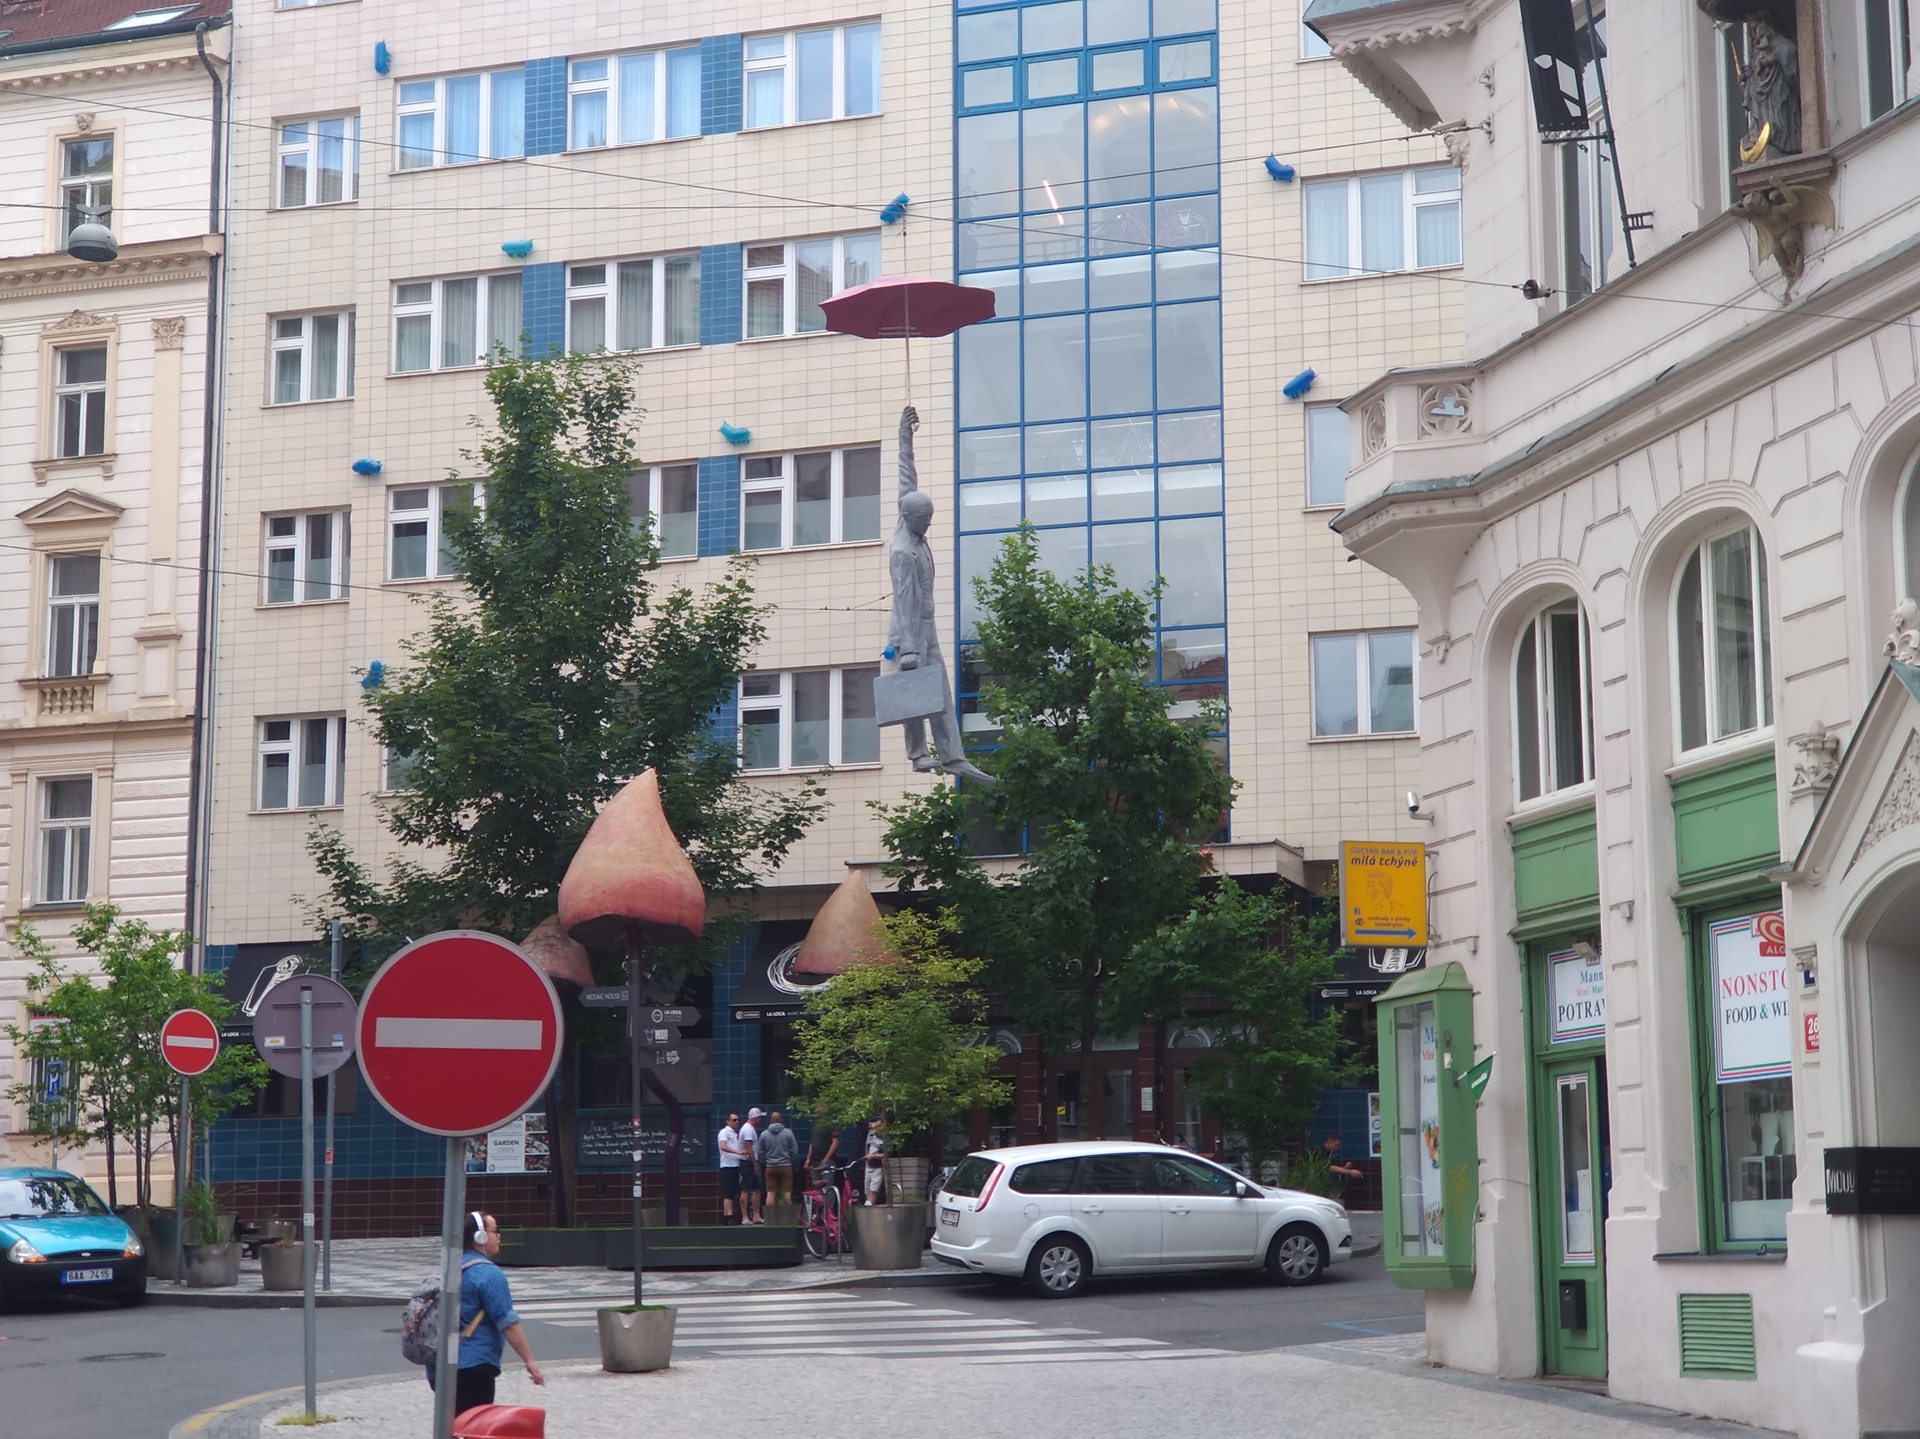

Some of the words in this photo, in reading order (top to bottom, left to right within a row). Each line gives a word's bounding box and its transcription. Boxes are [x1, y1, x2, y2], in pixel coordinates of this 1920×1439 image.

[1350, 855, 1376, 866] milá
[1379, 856, 1418, 868] tchýně
[1725, 1005, 1757, 1025] FOOD
[1759, 1003, 1768, 1019] &
[90, 1269, 110, 1280] 7415
